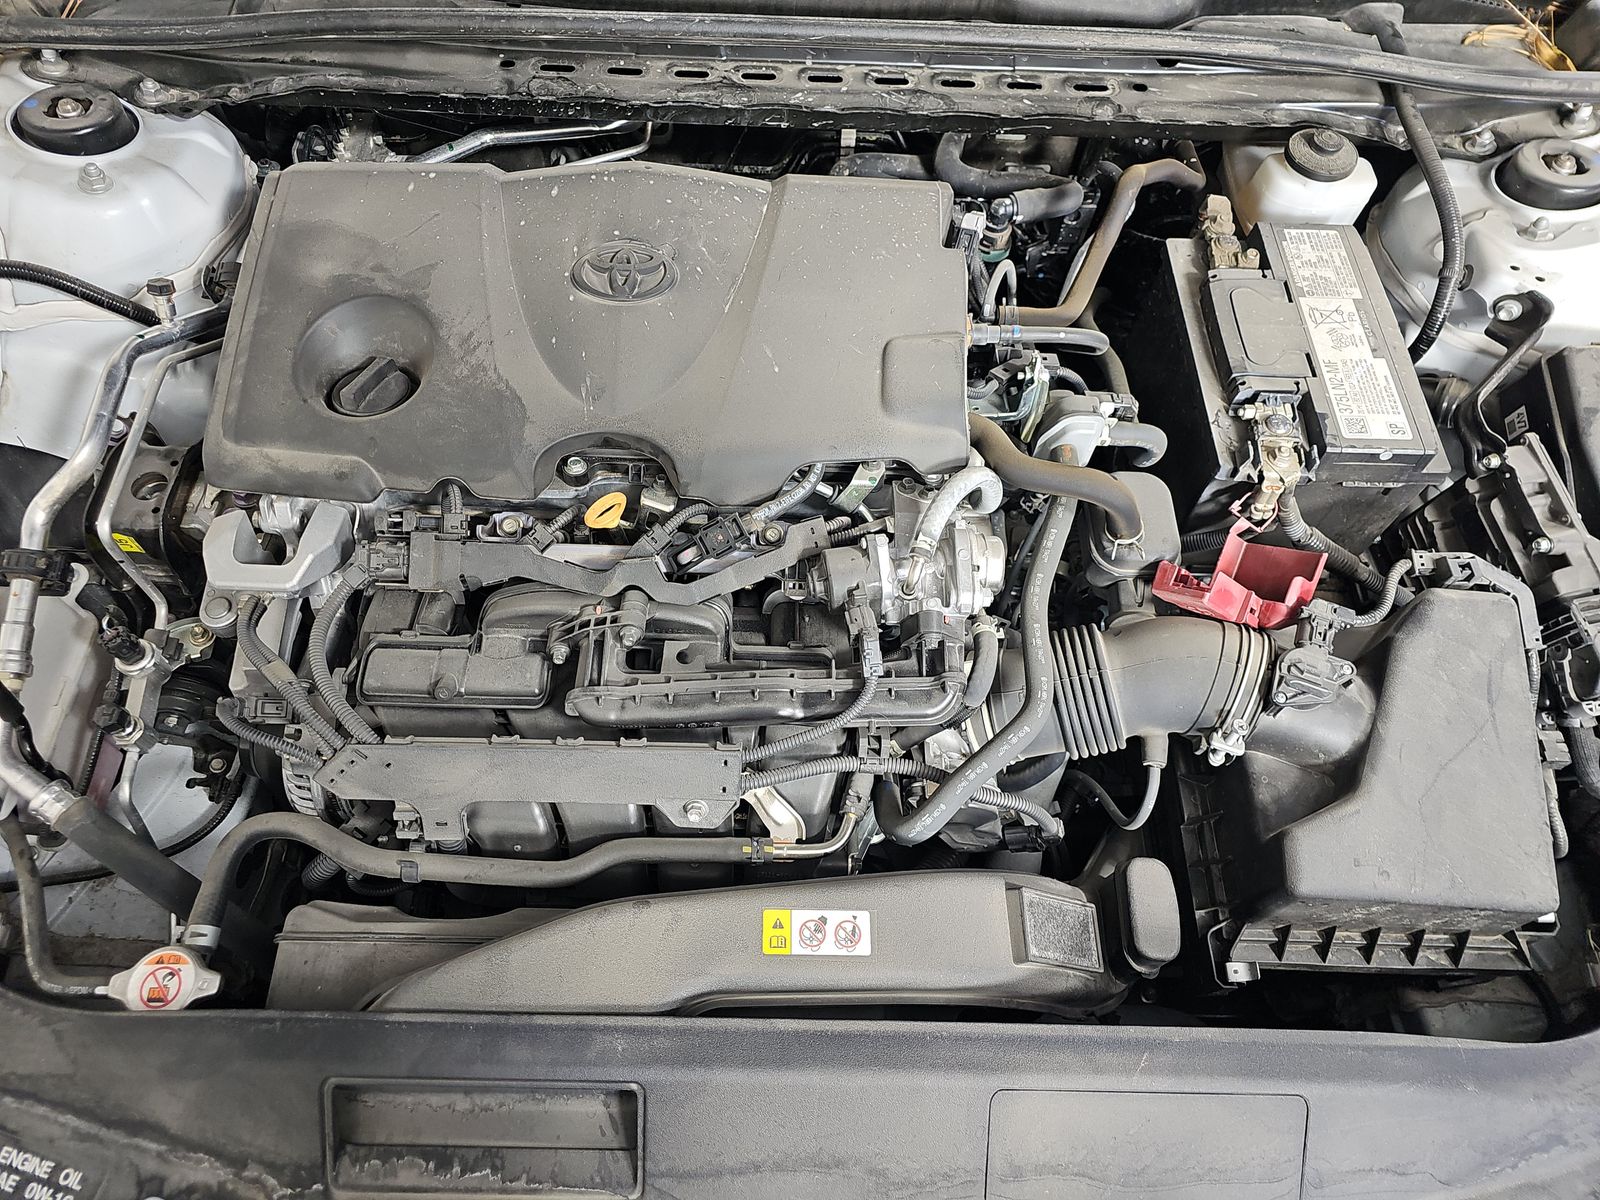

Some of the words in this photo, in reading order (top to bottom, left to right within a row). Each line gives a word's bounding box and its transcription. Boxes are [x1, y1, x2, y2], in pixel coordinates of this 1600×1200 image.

[1388, 423, 1406, 435] SP
[0, 1146, 56, 1179] ENGINE
[58, 1168, 83, 1191] OIL
[0, 1171, 20, 1193] AE
